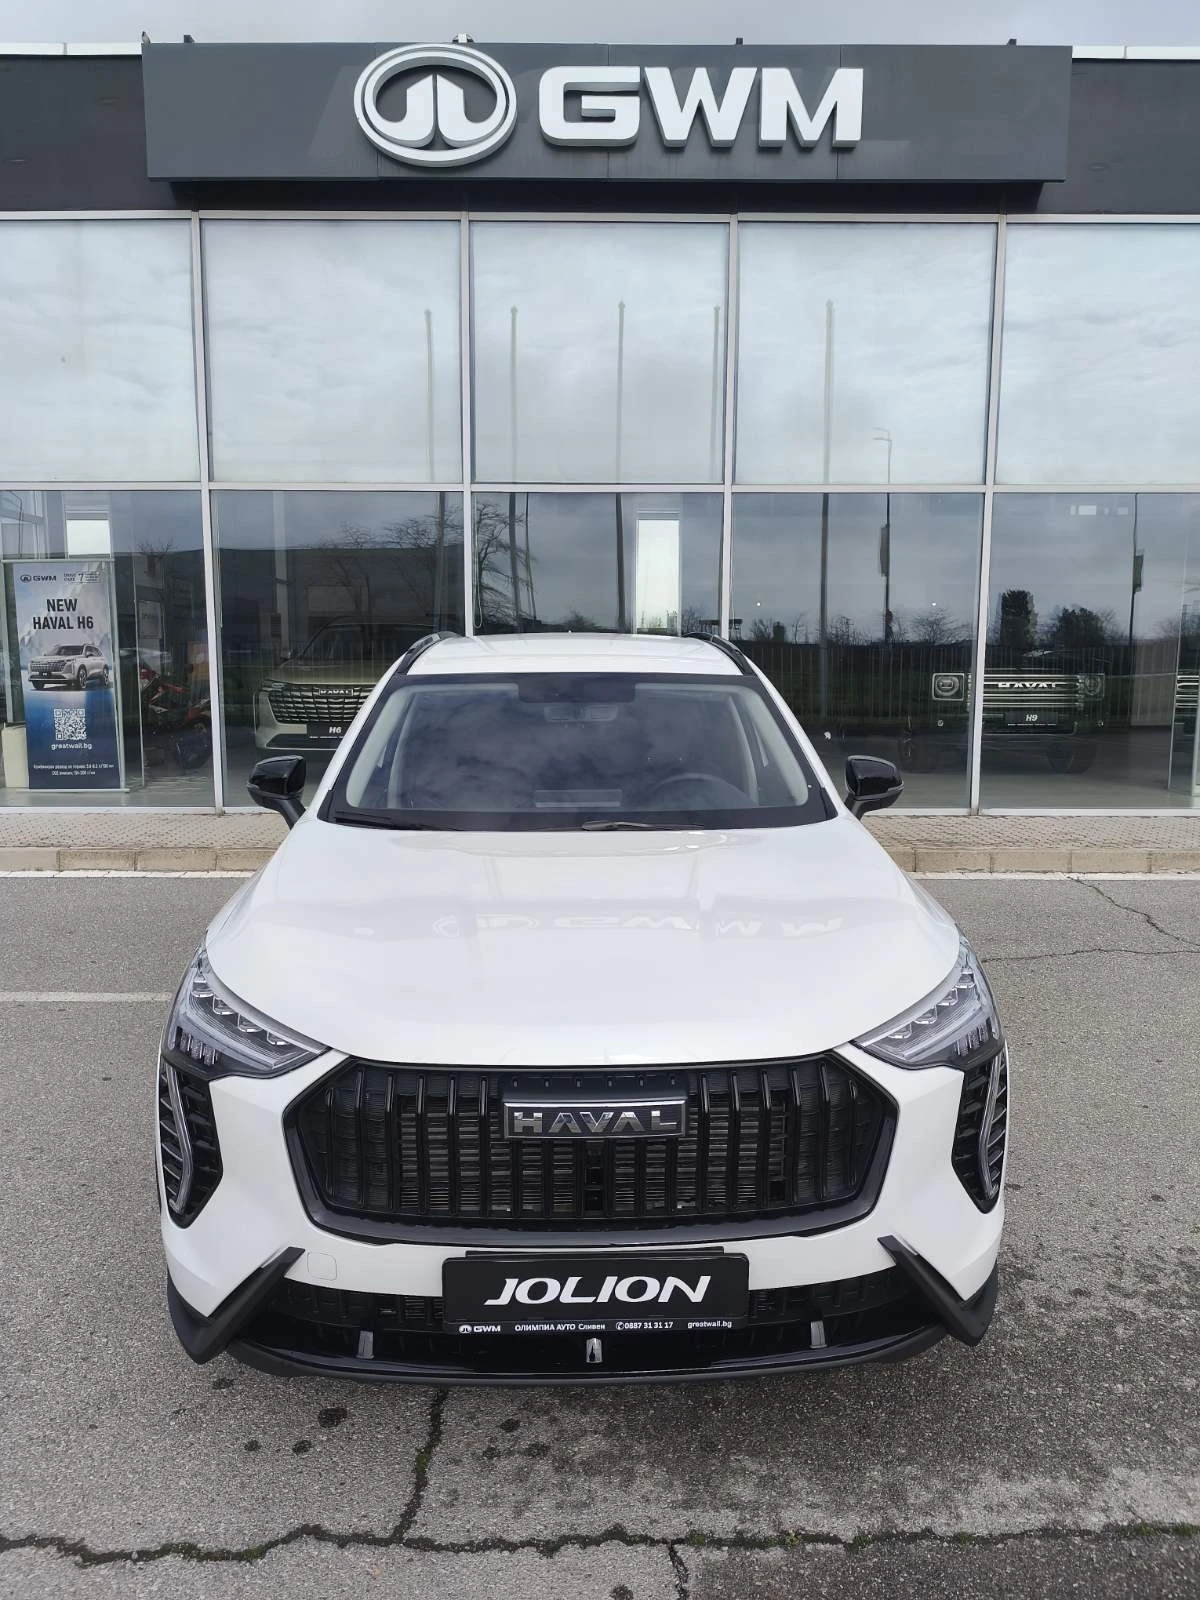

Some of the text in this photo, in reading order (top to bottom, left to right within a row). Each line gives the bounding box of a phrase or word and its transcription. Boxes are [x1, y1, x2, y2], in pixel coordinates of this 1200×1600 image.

[538, 65, 864, 149] GWM
[46, 598, 78, 612] NEW
[32, 616, 94, 630] HAVAL H6
[1025, 714, 1038, 722] H9
[328, 726, 342, 734] H6
[513, 1110, 677, 1133] HAVAL
[483, 1275, 712, 1306] JOLION
[473, 1324, 501, 1333] GWM
[556, 1323, 576, 1331] АУТО
[643, 1321, 653, 1329] 31
[664, 1320, 674, 1329] 17
